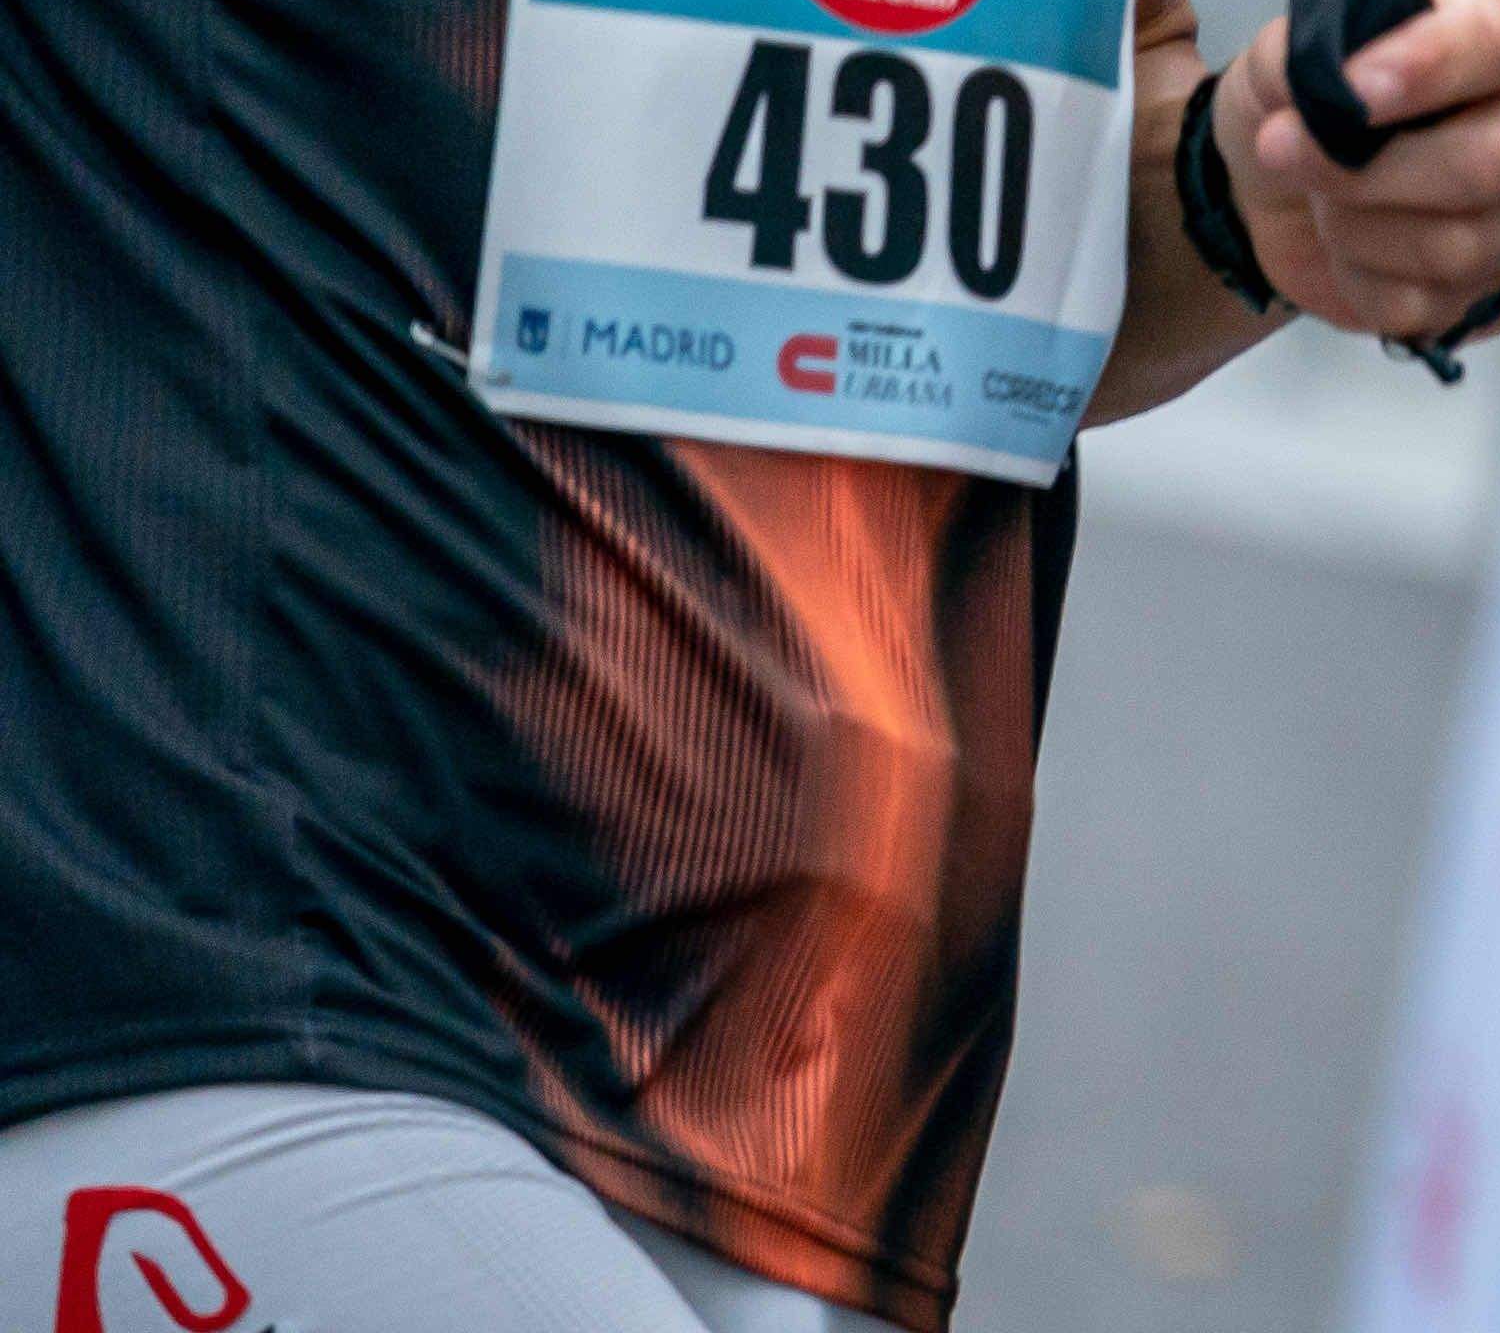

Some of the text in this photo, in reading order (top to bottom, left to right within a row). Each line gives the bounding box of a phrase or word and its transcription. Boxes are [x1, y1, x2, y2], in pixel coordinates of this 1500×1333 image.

[702, 37, 1035, 303] 430
[581, 317, 735, 371] MADRID
[848, 339, 942, 374] MILLA
